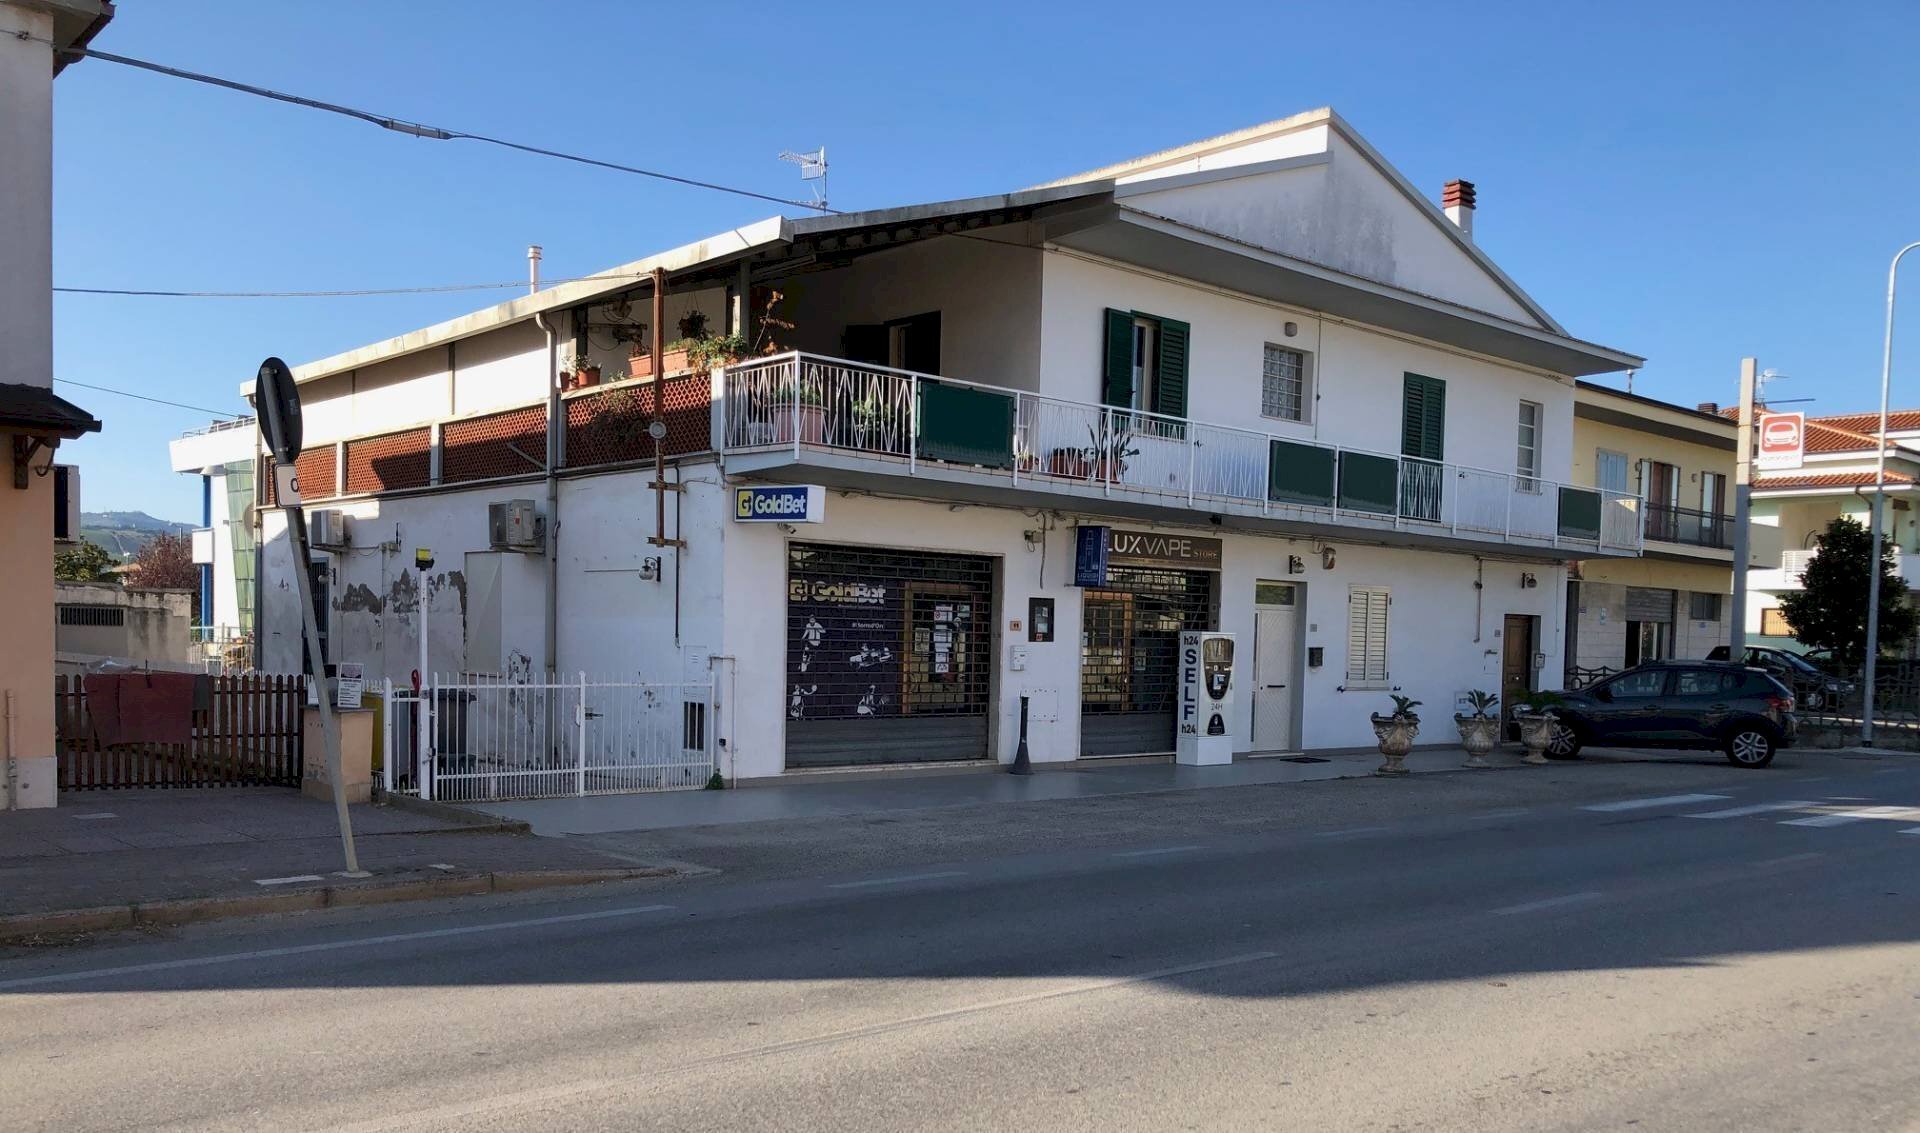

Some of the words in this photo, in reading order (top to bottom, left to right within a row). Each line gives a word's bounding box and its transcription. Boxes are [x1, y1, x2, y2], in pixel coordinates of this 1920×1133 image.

[754, 494, 806, 514] GoldBet
[1108, 534, 1192, 558] UXVAPE
[1184, 636, 1199, 646] h24
[1184, 649, 1197, 720] SELF
[1181, 724, 1196, 734] h24
